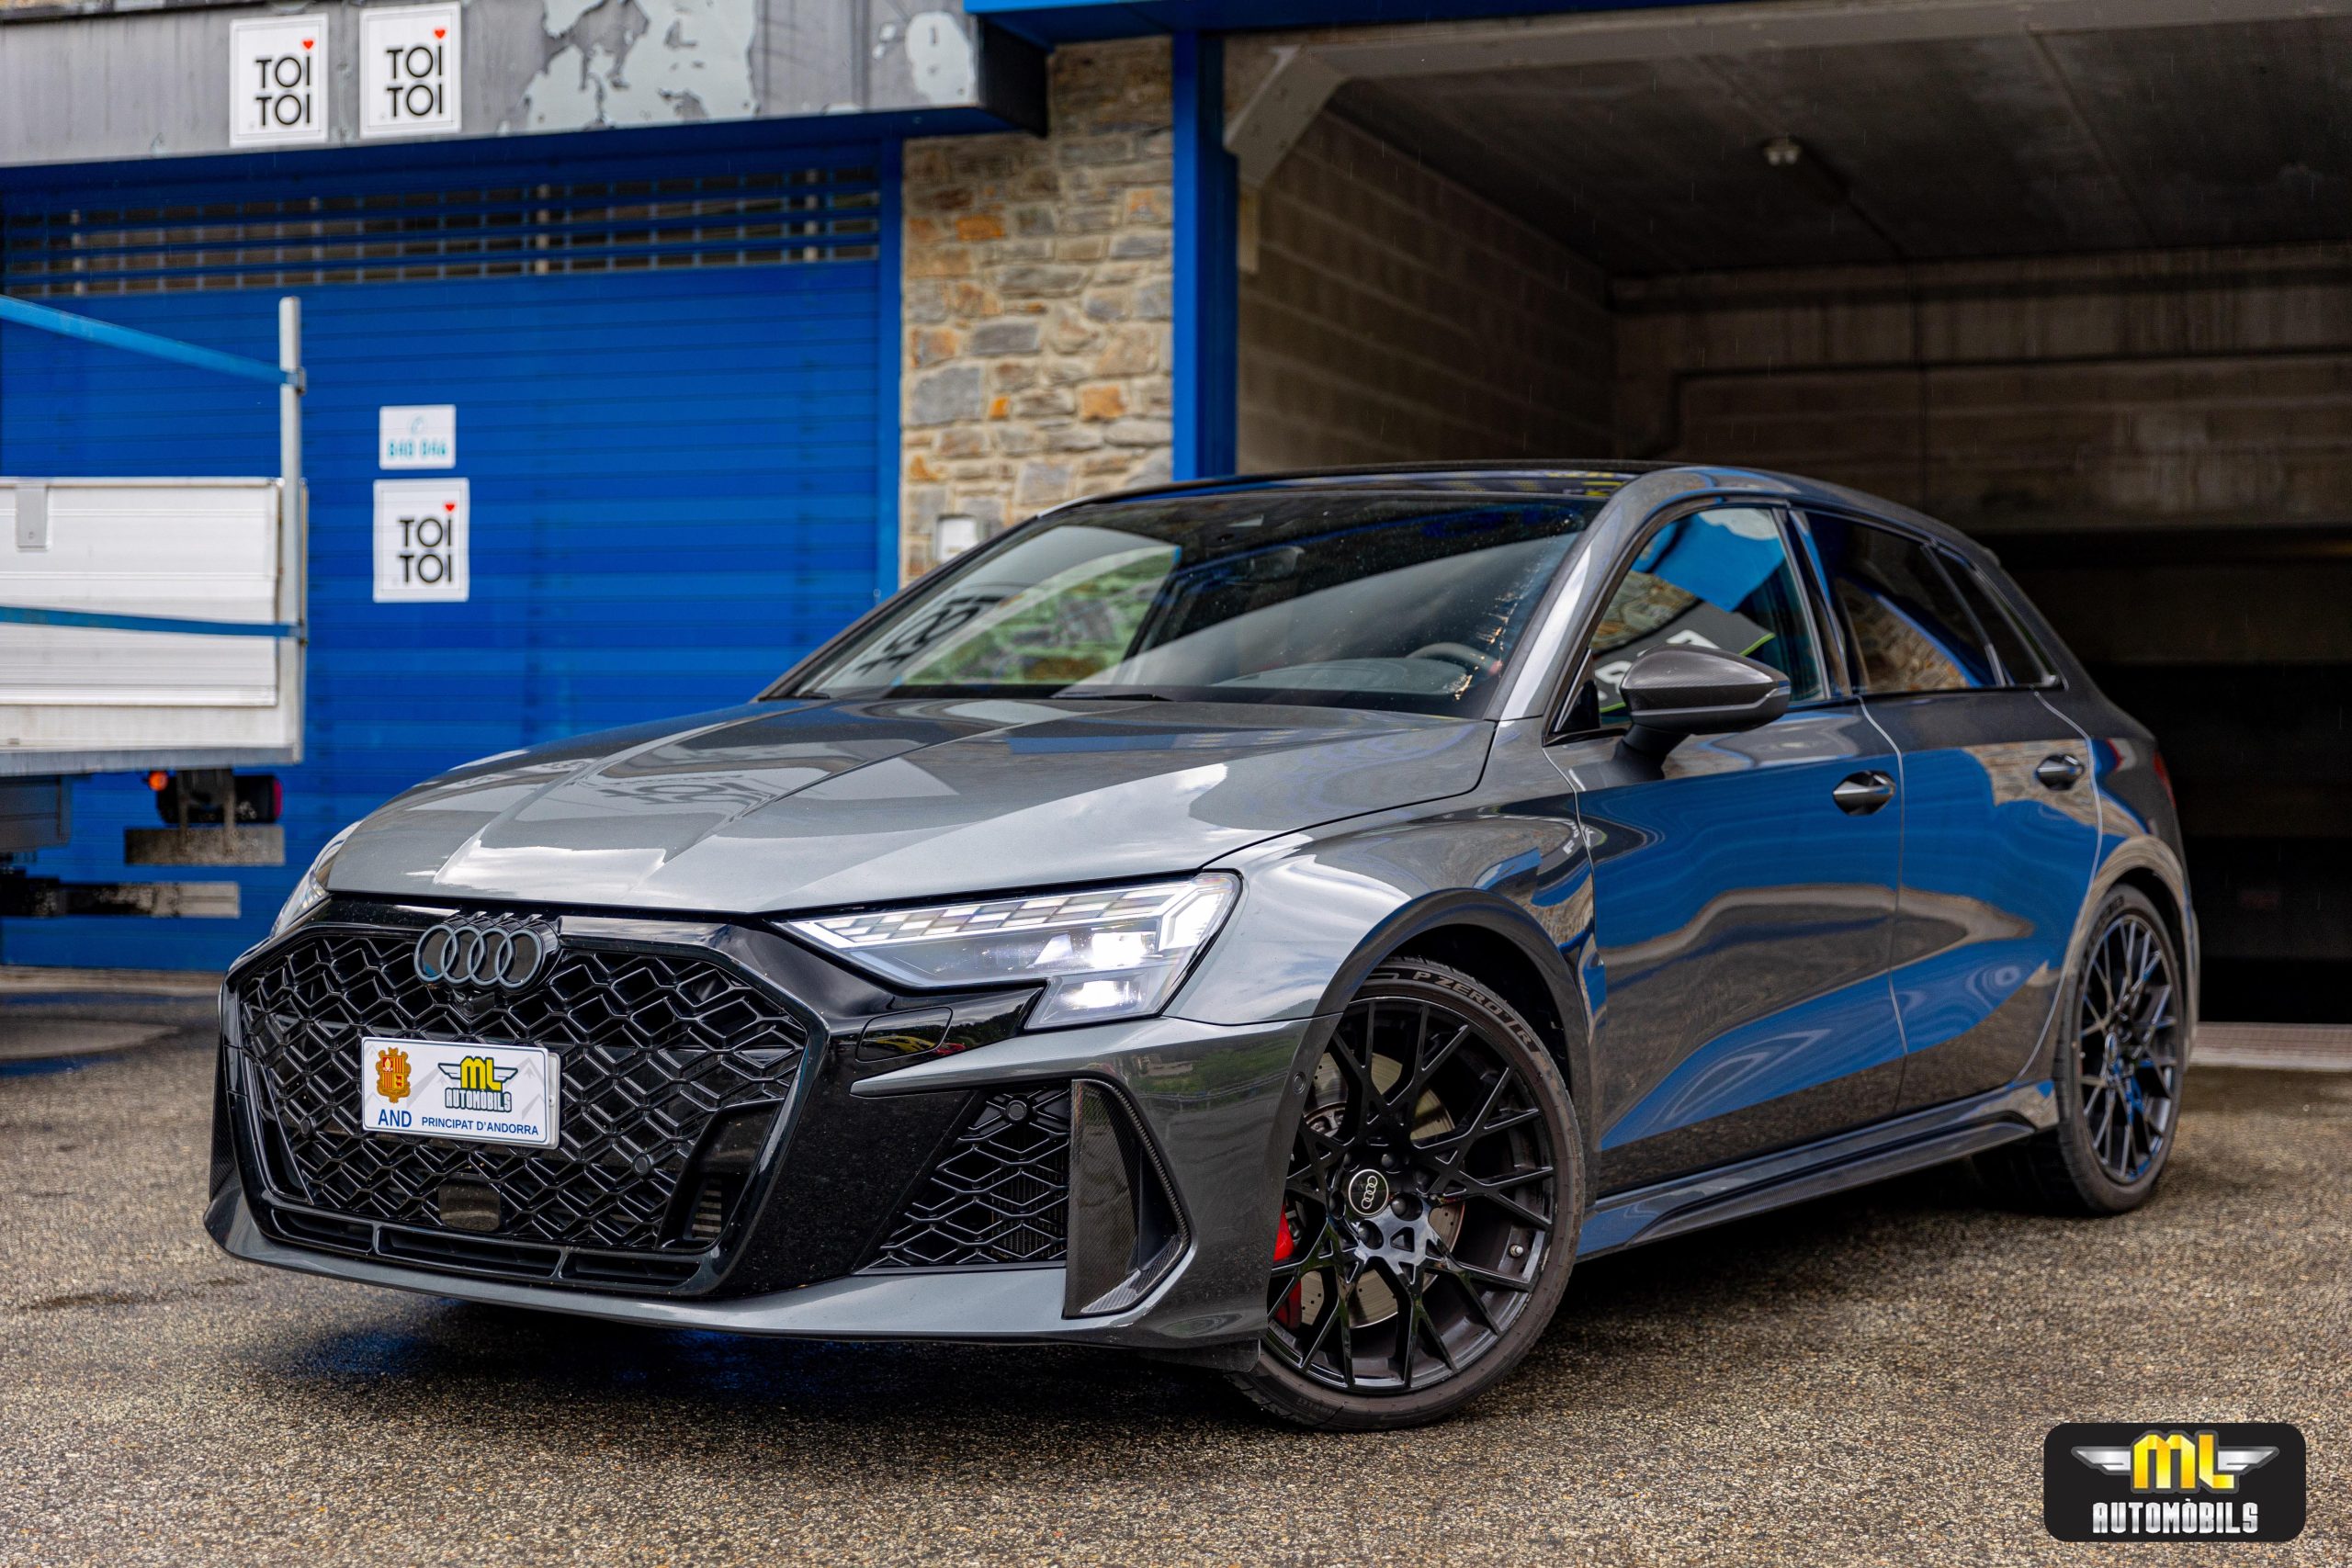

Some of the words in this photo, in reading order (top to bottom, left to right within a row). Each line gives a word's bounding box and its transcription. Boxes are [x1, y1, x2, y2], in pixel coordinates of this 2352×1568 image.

[254, 56, 311, 88] TOI
[386, 45, 442, 79] TOI
[254, 94, 311, 126] TOI
[386, 84, 442, 117] TOI
[397, 518, 452, 547] TOI
[397, 554, 452, 583] TOI
[1433, 976, 1504, 1015] ZERO
[460, 1056, 503, 1090] ML
[378, 1109, 412, 1128] AND
[422, 1116, 473, 1131] PRINCIPAT
[476, 1121, 538, 1136] D'ANDORRA
